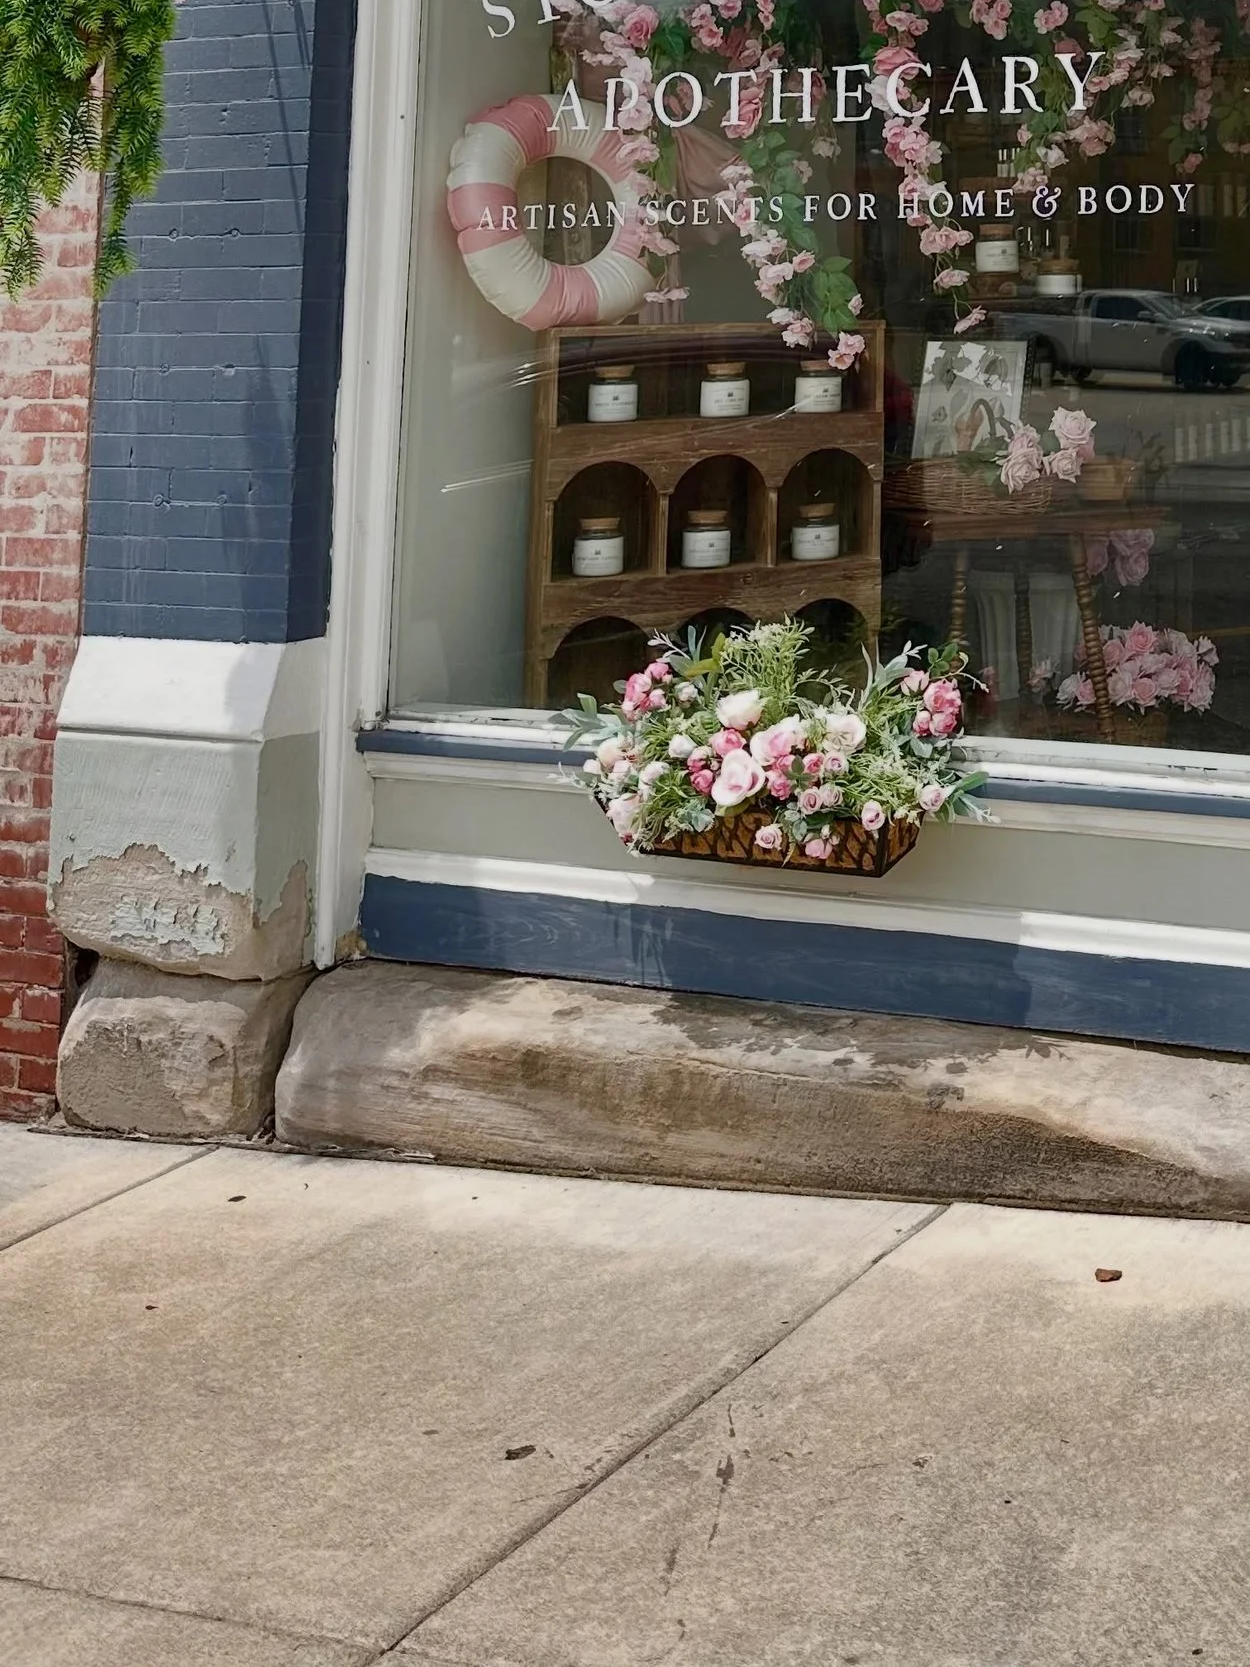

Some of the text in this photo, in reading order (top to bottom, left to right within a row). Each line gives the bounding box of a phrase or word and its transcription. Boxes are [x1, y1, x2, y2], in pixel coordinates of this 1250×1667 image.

[547, 51, 1106, 132] APOTHECARY
[476, 184, 1195, 231] ARTISAN SCENTS FOR HOME & BODY
